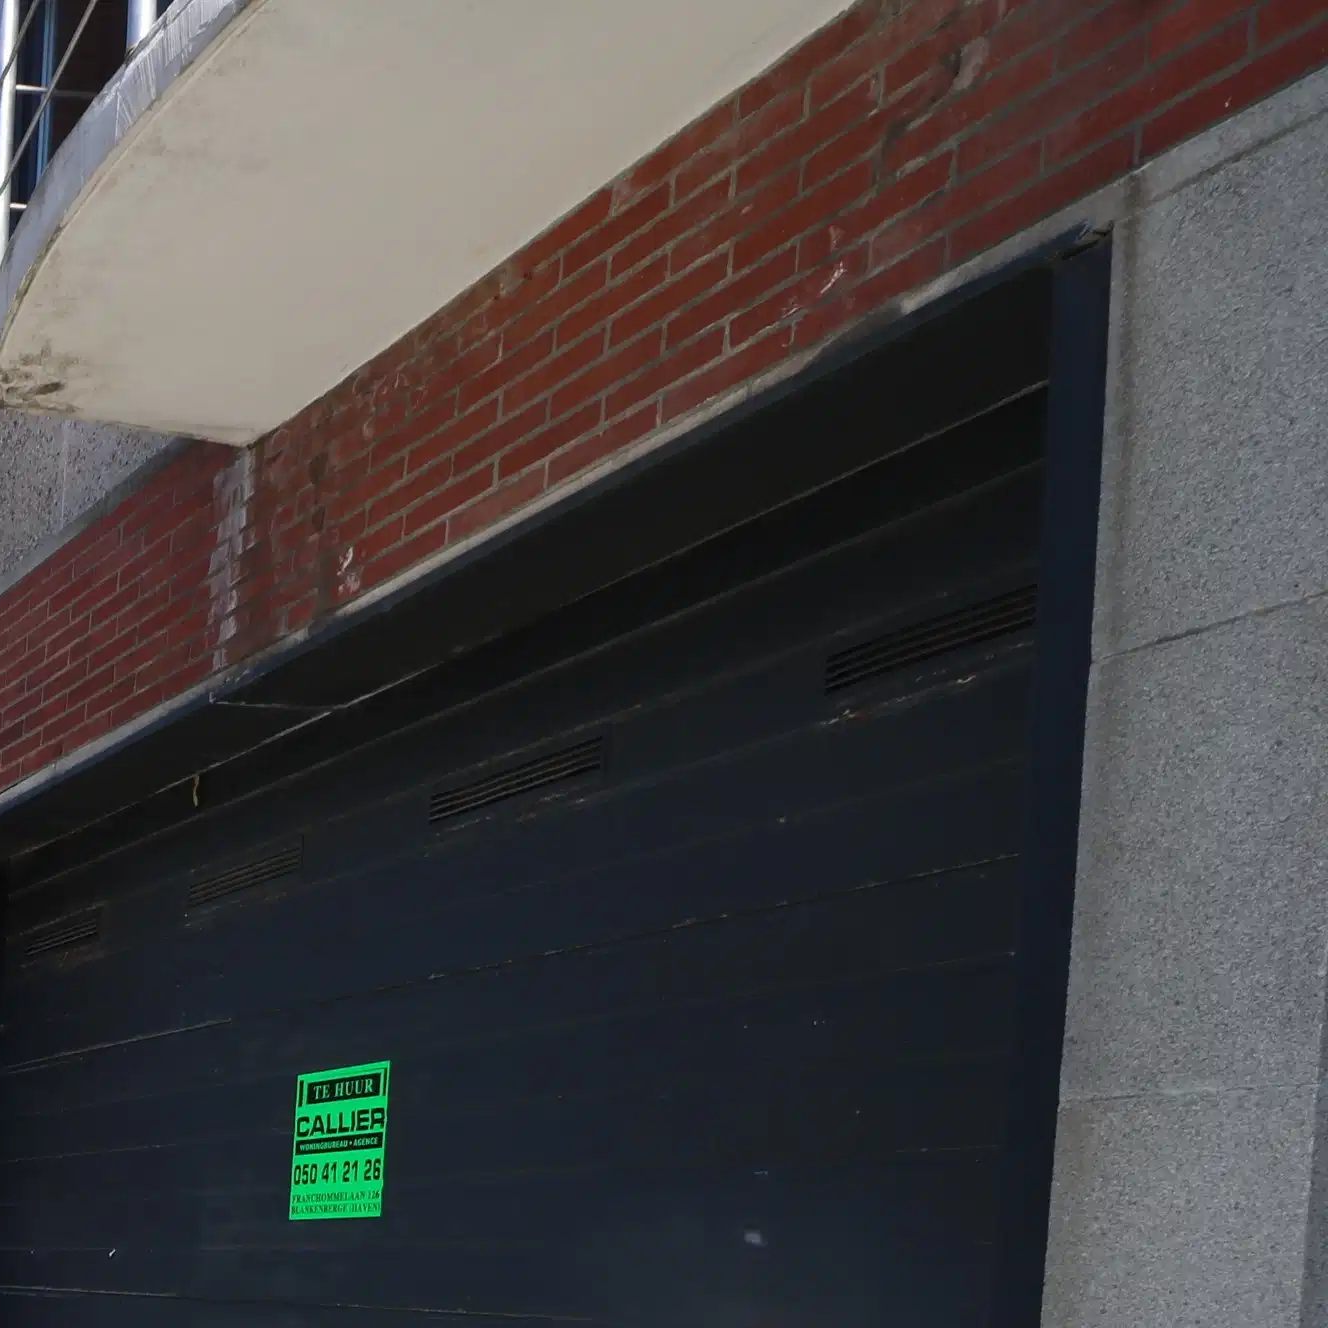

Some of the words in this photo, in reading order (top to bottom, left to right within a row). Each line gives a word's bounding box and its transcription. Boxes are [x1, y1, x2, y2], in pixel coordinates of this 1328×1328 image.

[314, 1084, 330, 1100] TE
[334, 1078, 374, 1098] HUUR
[296, 1107, 386, 1138] CALLIER
[299, 1140, 348, 1151] WONINGBUREAU
[353, 1136, 379, 1148] AGENCE
[293, 1163, 318, 1186] 050
[322, 1161, 338, 1184] 41
[342, 1160, 359, 1183] 21
[364, 1158, 382, 1181] 26
